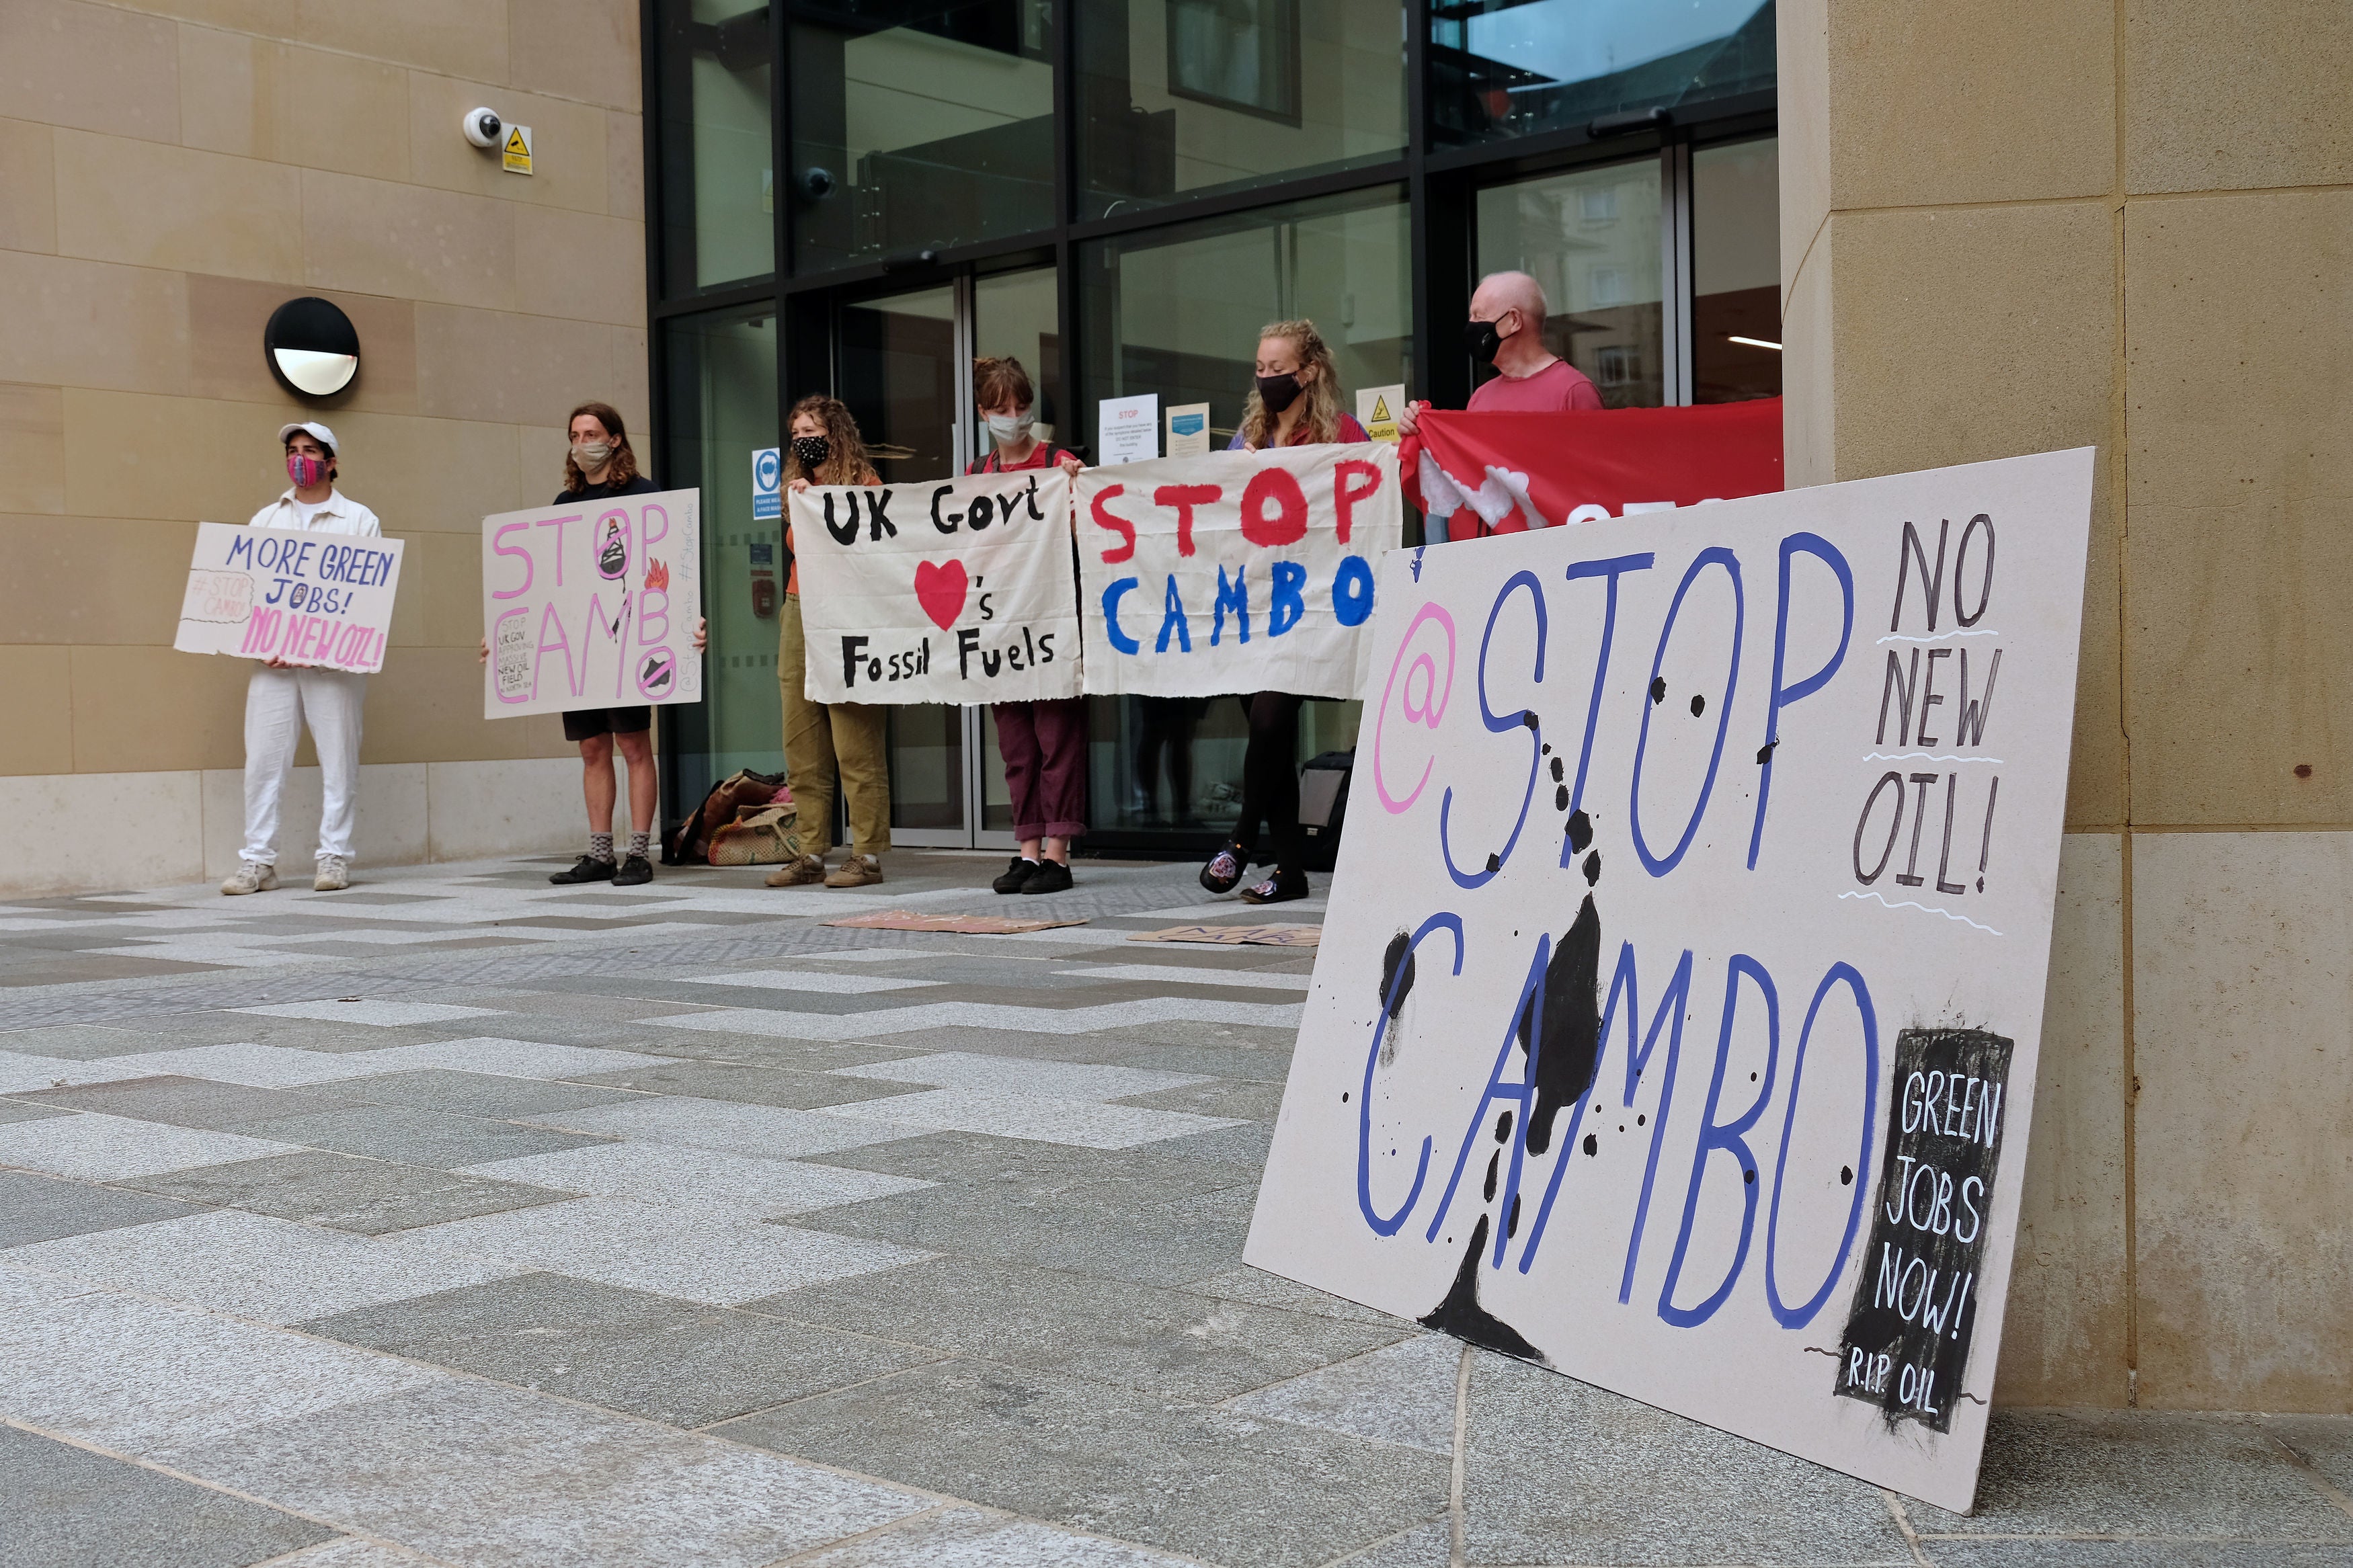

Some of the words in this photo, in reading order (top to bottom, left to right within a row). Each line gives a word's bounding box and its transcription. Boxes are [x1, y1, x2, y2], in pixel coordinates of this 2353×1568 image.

[1118, 409, 1139, 419] STOP
[1369, 428, 1395, 438] Caution
[824, 488, 898, 546] UK
[1090, 459, 1383, 564] STOP
[226, 534, 317, 577] MORE
[319, 544, 395, 587] GREEN
[492, 504, 670, 600] STOP
[1890, 513, 1995, 632] NO
[266, 578, 354, 615] JOBS!
[502, 617, 526, 632] STOP
[1101, 555, 1375, 655] CAMBO
[241, 606, 283, 654] NO
[280, 614, 342, 661] NEW
[335, 624, 385, 667] OIL!
[493, 587, 677, 704] CAMBO
[498, 634, 510, 646] UK
[510, 631, 525, 643] GOV
[842, 635, 930, 689] Fossil
[957, 626, 1055, 680] Fuels
[497, 665, 516, 675] NEW
[517, 663, 530, 673] OIL
[502, 673, 523, 686] FIELD
[1876, 647, 2003, 747] NEW
[1853, 771, 1999, 895] OIL!
[1357, 910, 1880, 1331] CAMBO
[1901, 1070, 2002, 1149] GREEN
[1886, 1155, 1984, 1244] JOBS
[1874, 1241, 1972, 1339] NOW!
[1899, 1362, 1939, 1415] OIL
